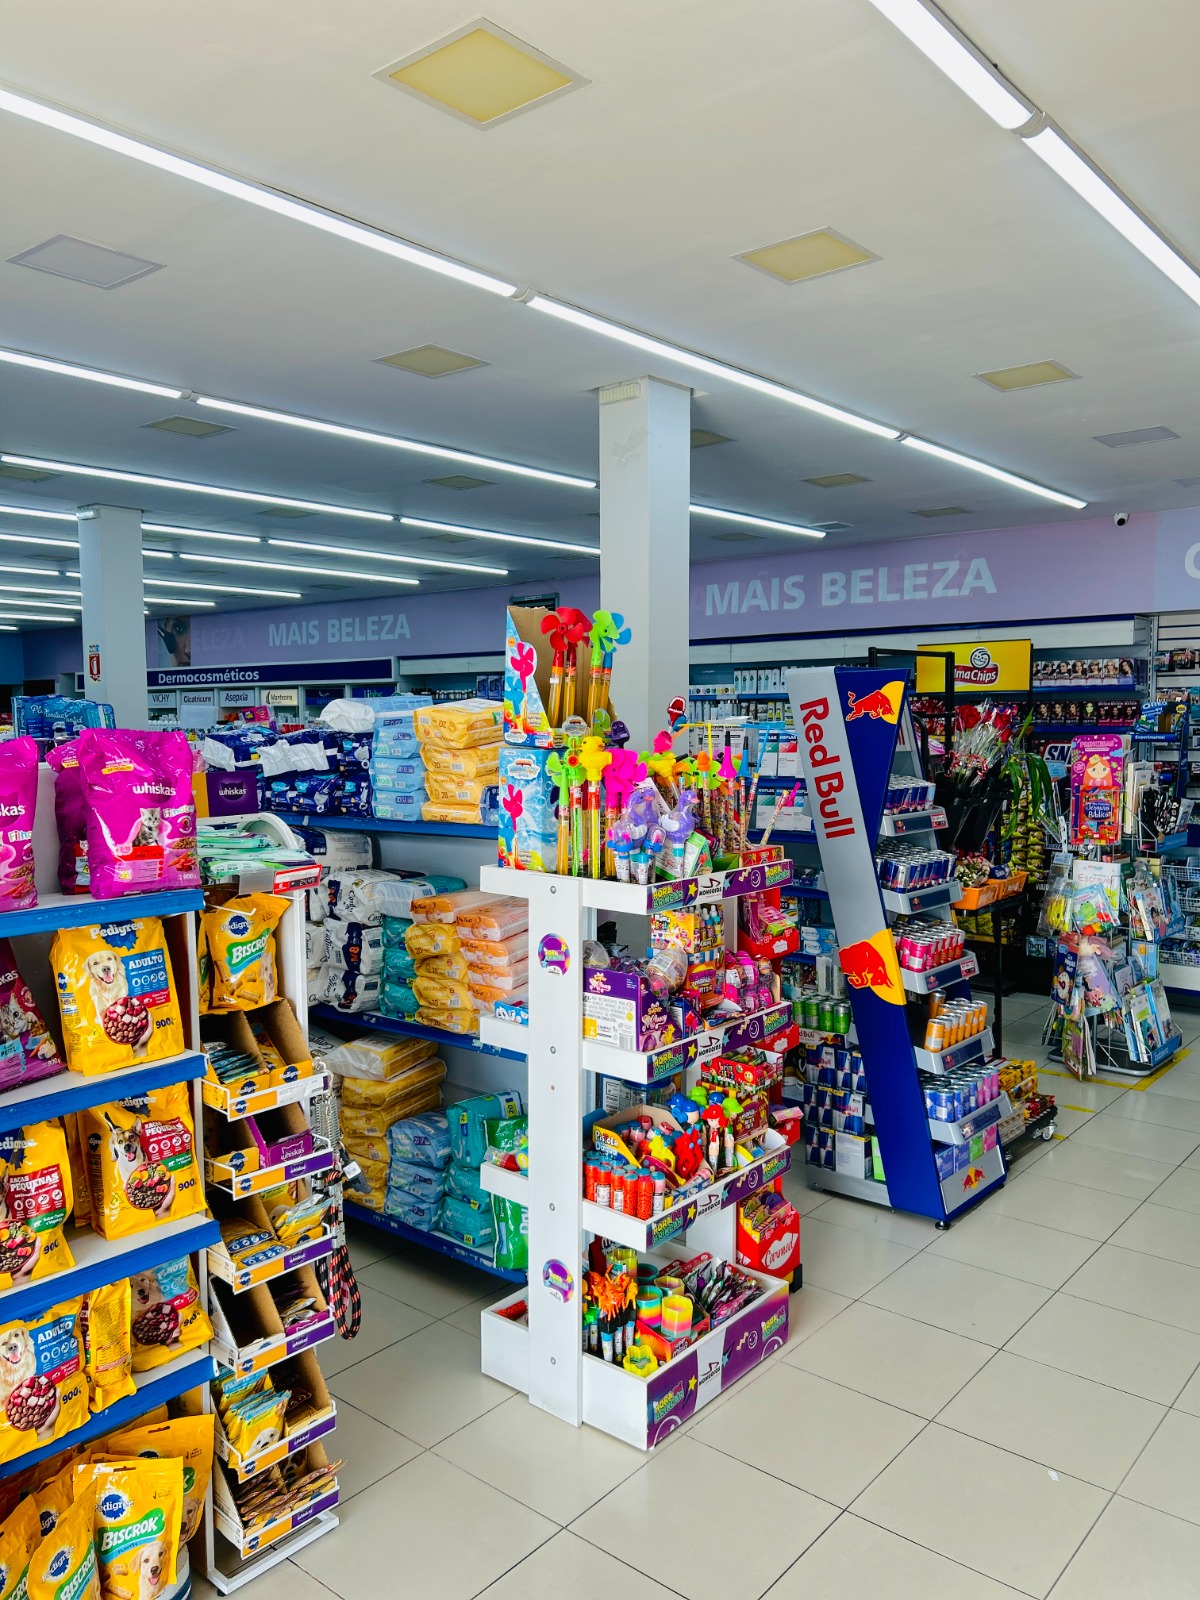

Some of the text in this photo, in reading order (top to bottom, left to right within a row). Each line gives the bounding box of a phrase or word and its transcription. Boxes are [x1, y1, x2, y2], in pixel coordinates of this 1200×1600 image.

[705, 557, 997, 616] MAIS BELEZA
[268, 613, 411, 647] MAIS BELEZA
[158, 669, 260, 684] Dermocosméticos
[971, 669, 997, 683] Chips
[152, 693, 170, 703] VICHY
[183, 695, 212, 704] Cicatricure
[225, 692, 249, 702] Asepxia
[799, 697, 856, 839] Red Bull
[132, 782, 177, 796] whiskas
[219, 787, 247, 796] whiskas
[766, 865, 781, 876] HORA
[766, 869, 790, 887] BRINCAR
[653, 886, 672, 899] HORA
[653, 891, 683, 909] BRINCAR
[90, 921, 144, 939] Pedigree
[128, 954, 164, 970] ADULTO
[764, 1011, 779, 1025] HORA
[764, 1014, 788, 1036] BRINCAR
[654, 1051, 672, 1066] HORA
[654, 1054, 683, 1078] BRINCAR
[10, 1172, 59, 1192] PEQUENAS
[653, 1217, 683, 1244] BRINCAR
[654, 1217, 672, 1234] HORA
[37, 1320, 73, 1344] ADULTO
[95, 1498, 134, 1513] Pedigree
[101, 1514, 162, 1551] BISCROK
